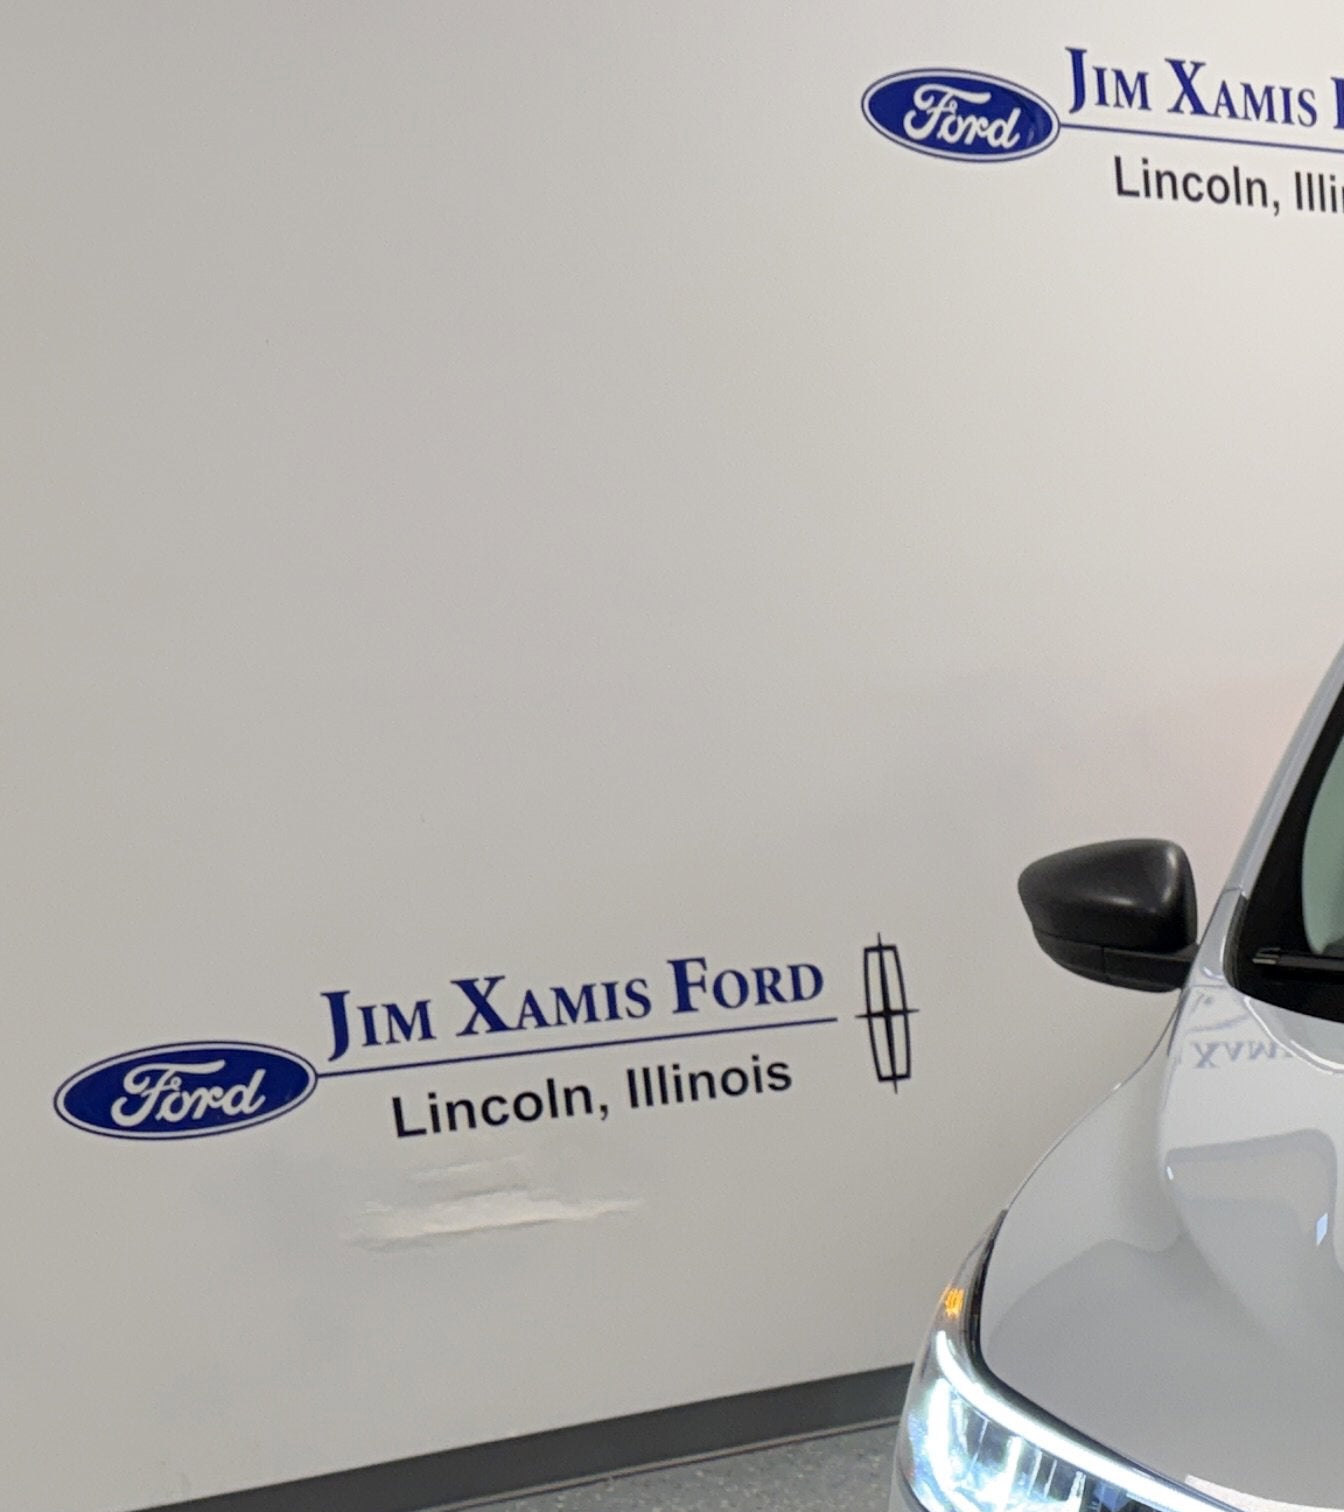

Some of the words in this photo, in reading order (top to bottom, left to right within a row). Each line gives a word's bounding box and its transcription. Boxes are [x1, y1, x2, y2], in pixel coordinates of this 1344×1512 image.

[902, 83, 1021, 149] Ford
[1066, 47, 1151, 114] JIM
[1165, 58, 1318, 127] XAMIS
[1114, 156, 1280, 216] Lincoln,
[321, 990, 437, 1061] JIM
[451, 975, 652, 1037] XAMIS
[667, 957, 826, 1015] FORD
[109, 1058, 267, 1126] Ford
[392, 1077, 608, 1138] Lincoln,
[626, 1054, 793, 1109] Illinois
